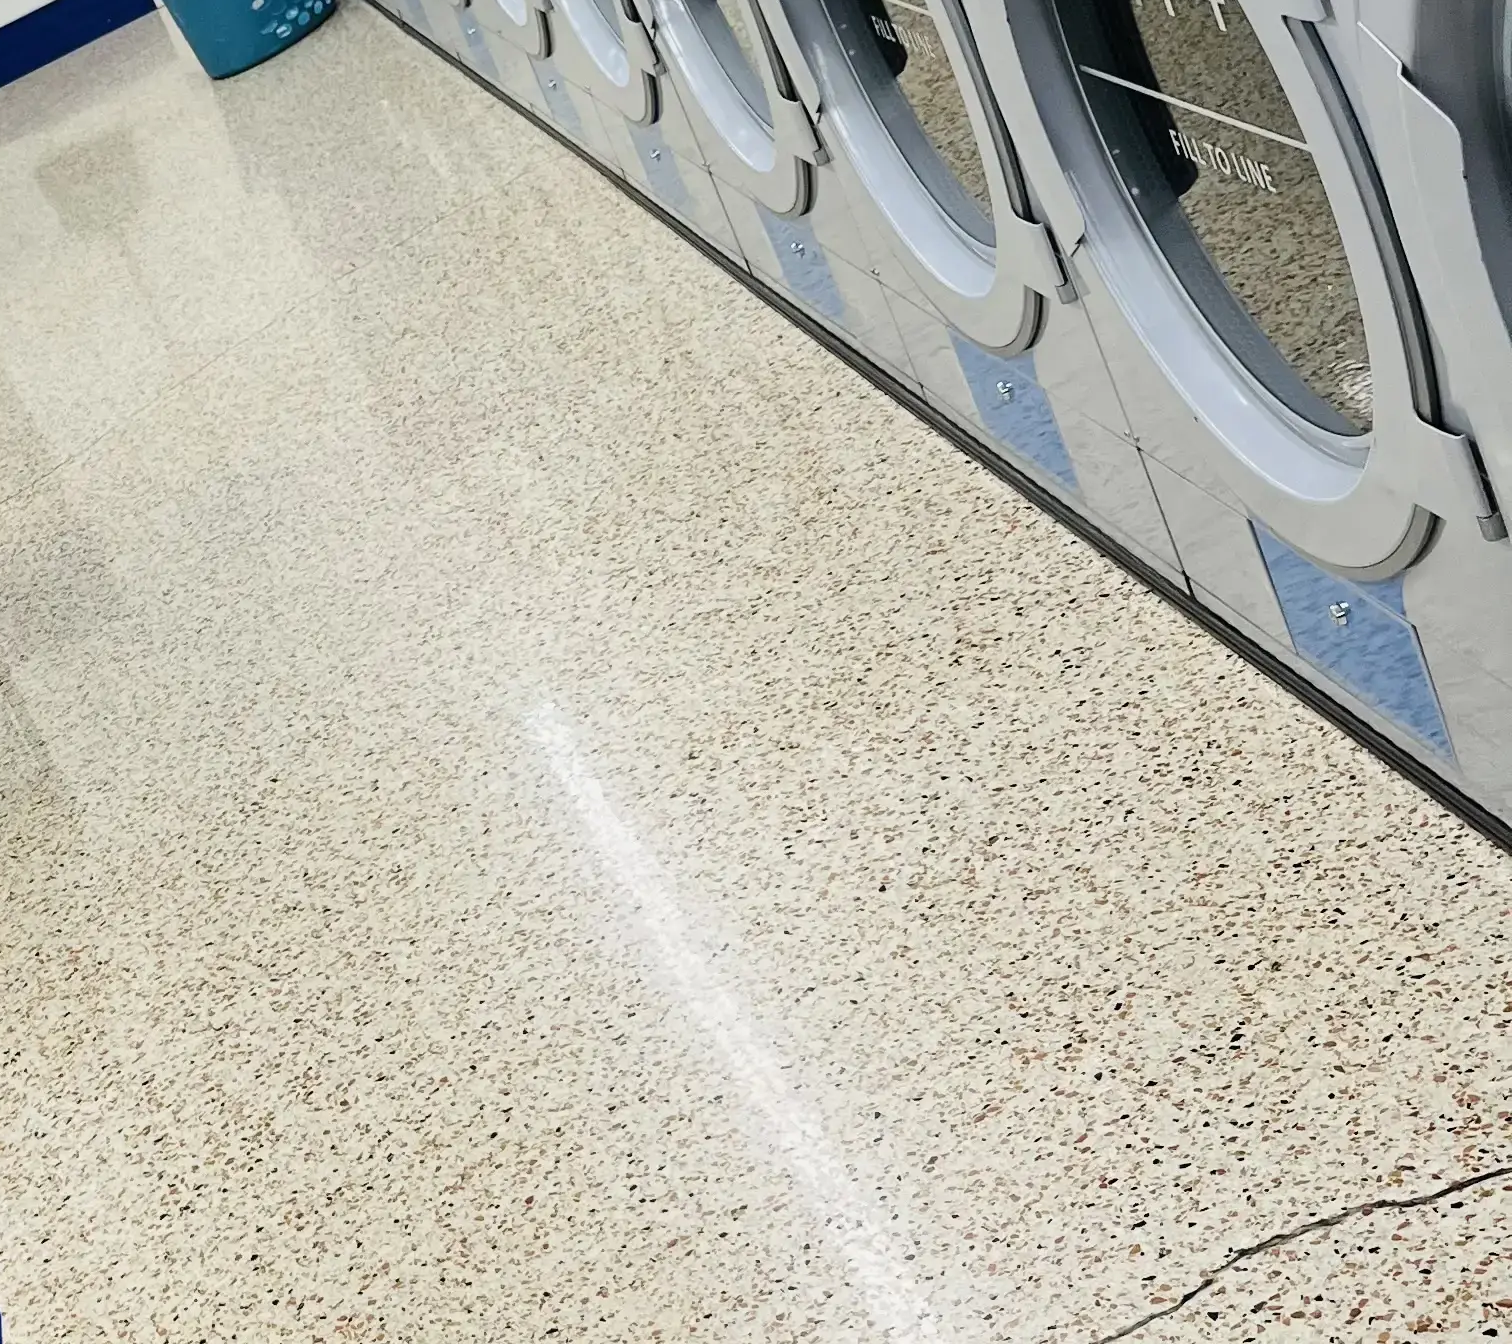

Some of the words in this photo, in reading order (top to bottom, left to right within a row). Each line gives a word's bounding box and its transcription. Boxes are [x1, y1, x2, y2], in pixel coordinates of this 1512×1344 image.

[871, 15, 896, 43] FILL
[1169, 128, 1207, 165] FILL
[1203, 142, 1231, 175] TO
[1231, 152, 1277, 193] LINE
